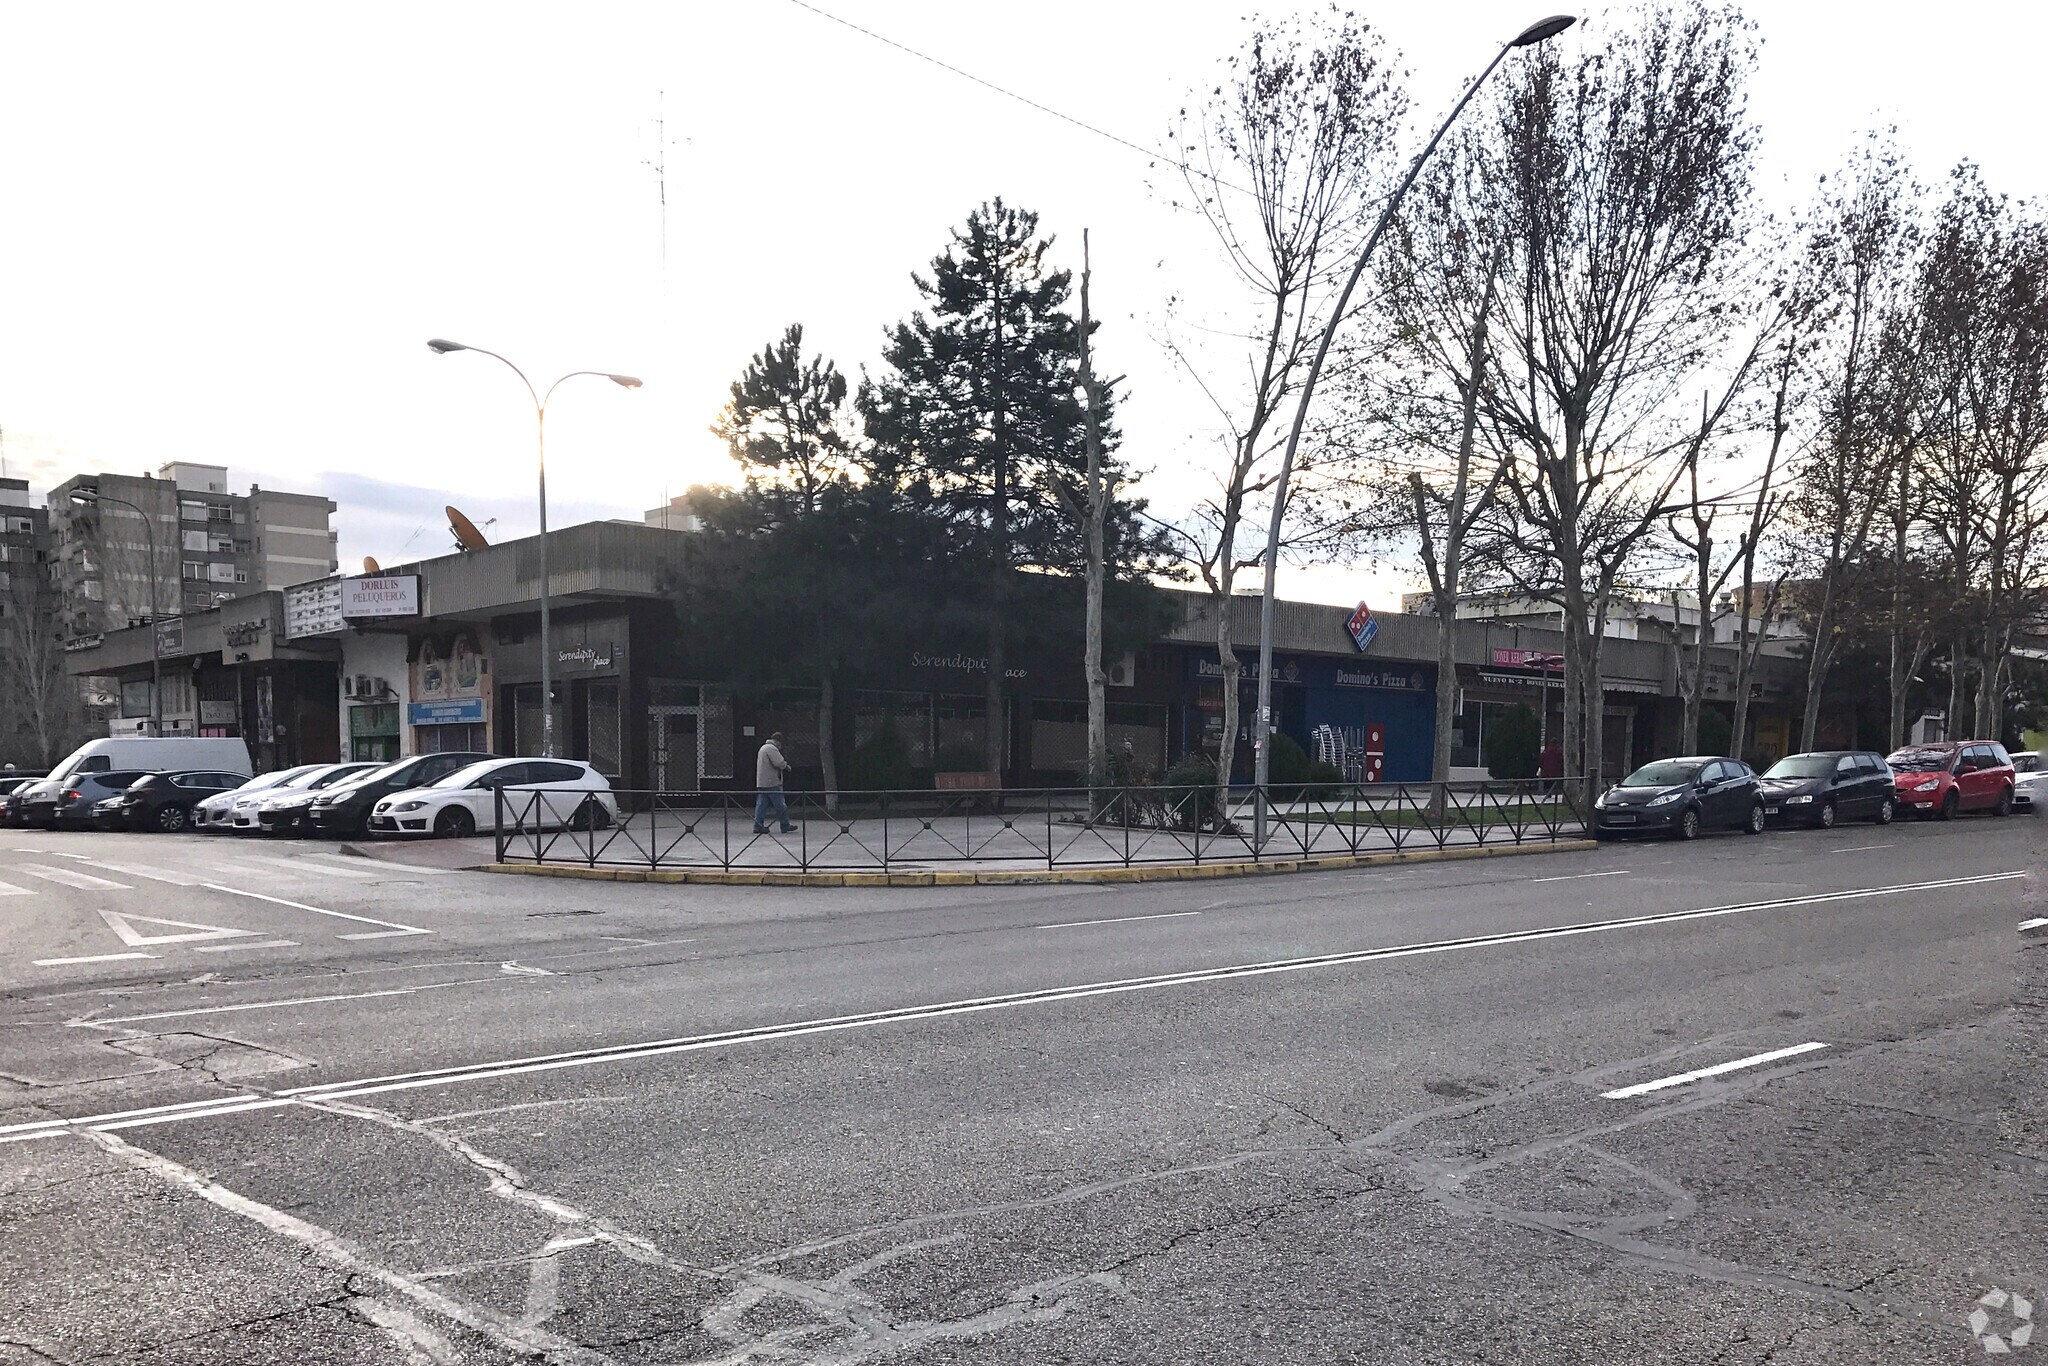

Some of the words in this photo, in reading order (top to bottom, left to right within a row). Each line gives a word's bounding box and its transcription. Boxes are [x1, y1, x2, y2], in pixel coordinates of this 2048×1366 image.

[361, 580, 399, 591] DORLUIS
[352, 591, 407, 604] PELUQUEROS
[558, 648, 595, 663] Serendipity
[593, 656, 610, 669] place
[911, 651, 989, 673] Serendipit
[1005, 668, 1028, 678] ace
[1336, 669, 1379, 686] Domino's
[1382, 672, 1407, 687] Pizza
